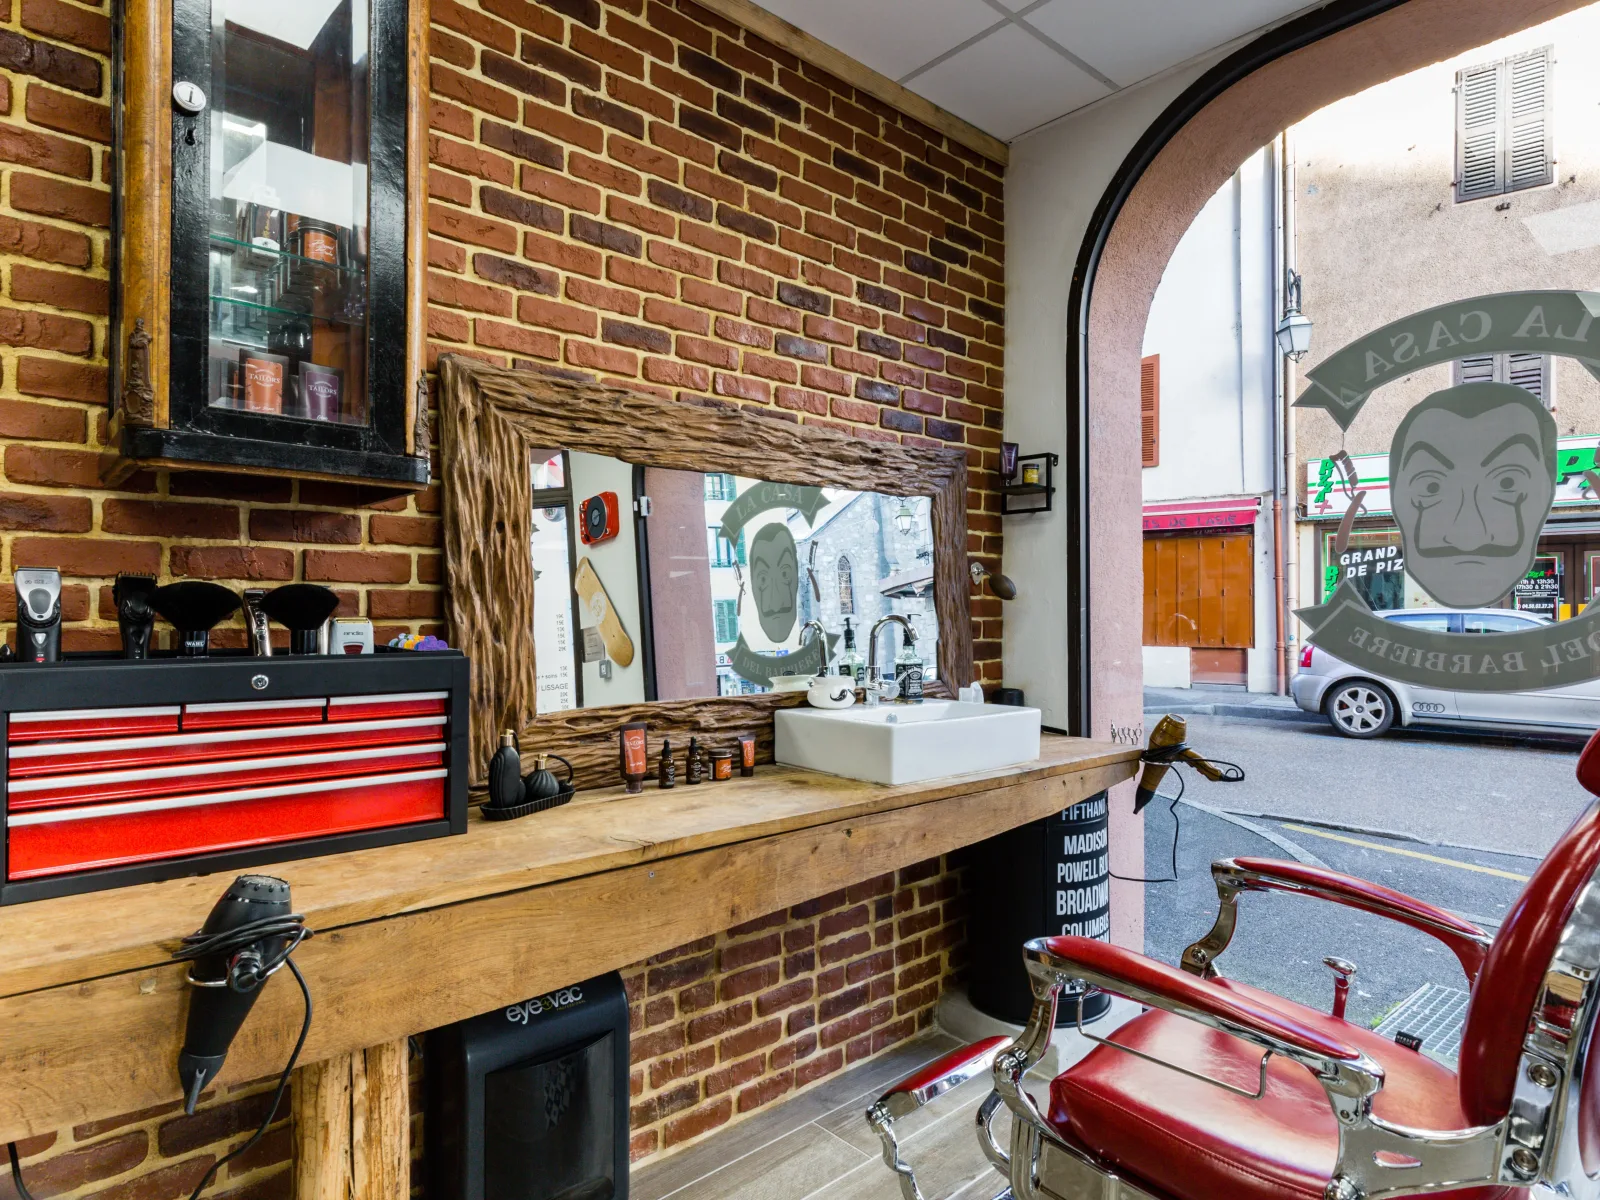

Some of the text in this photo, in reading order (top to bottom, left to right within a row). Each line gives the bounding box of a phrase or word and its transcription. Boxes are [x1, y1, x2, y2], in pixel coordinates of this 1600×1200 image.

[736, 484, 804, 520] LA CASA
[1340, 546, 1398, 566] GRAND
[1346, 565, 1367, 578] DE
[541, 683, 568, 691] LISSAGE
[1057, 858, 1098, 883] POWELL
